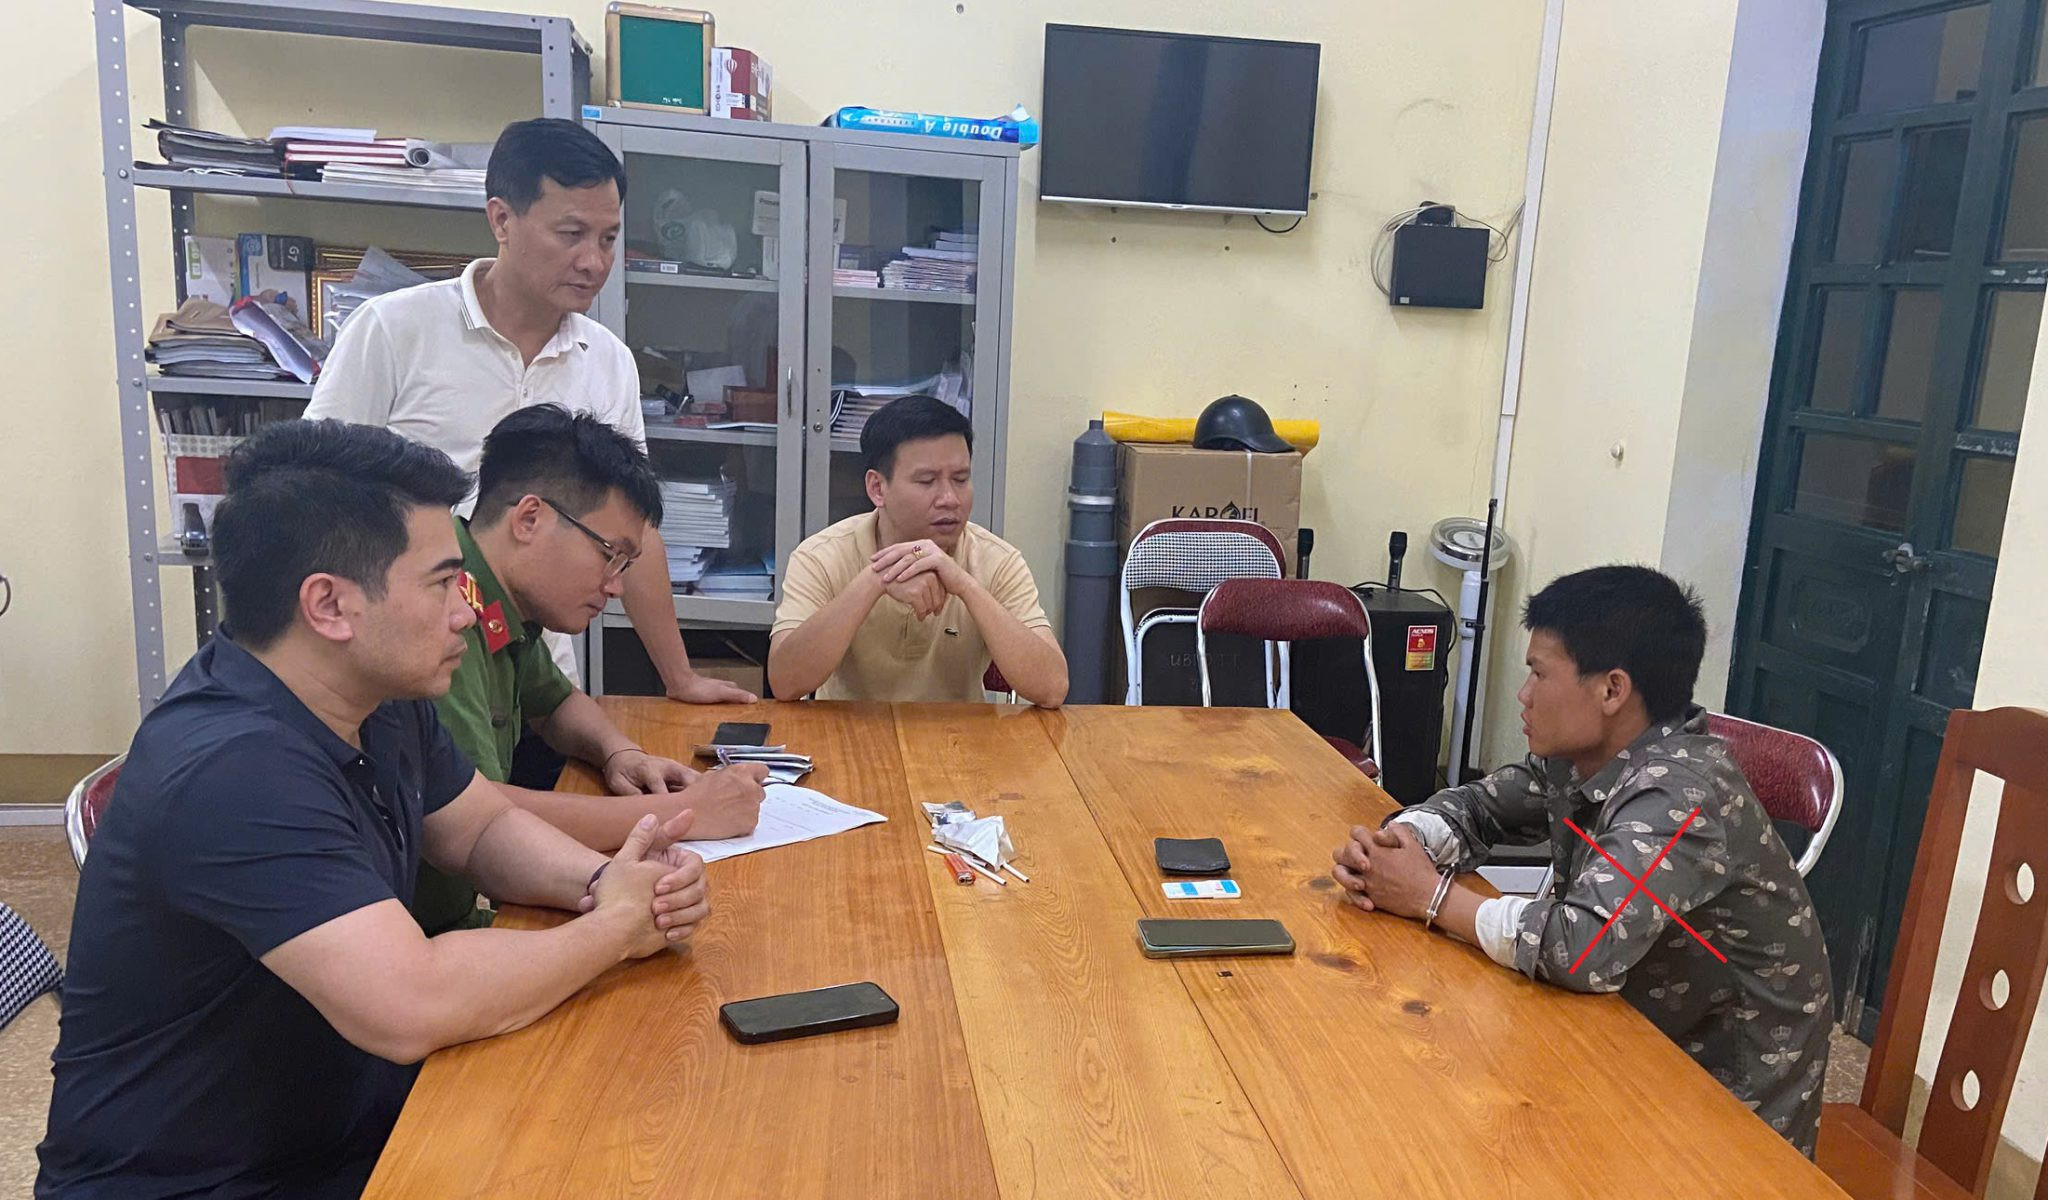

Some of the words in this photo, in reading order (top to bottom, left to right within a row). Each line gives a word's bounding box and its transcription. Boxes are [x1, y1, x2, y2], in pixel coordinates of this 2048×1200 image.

[924, 119, 936, 133] A
[943, 120, 1003, 139] Double
[288, 246, 300, 262] G7
